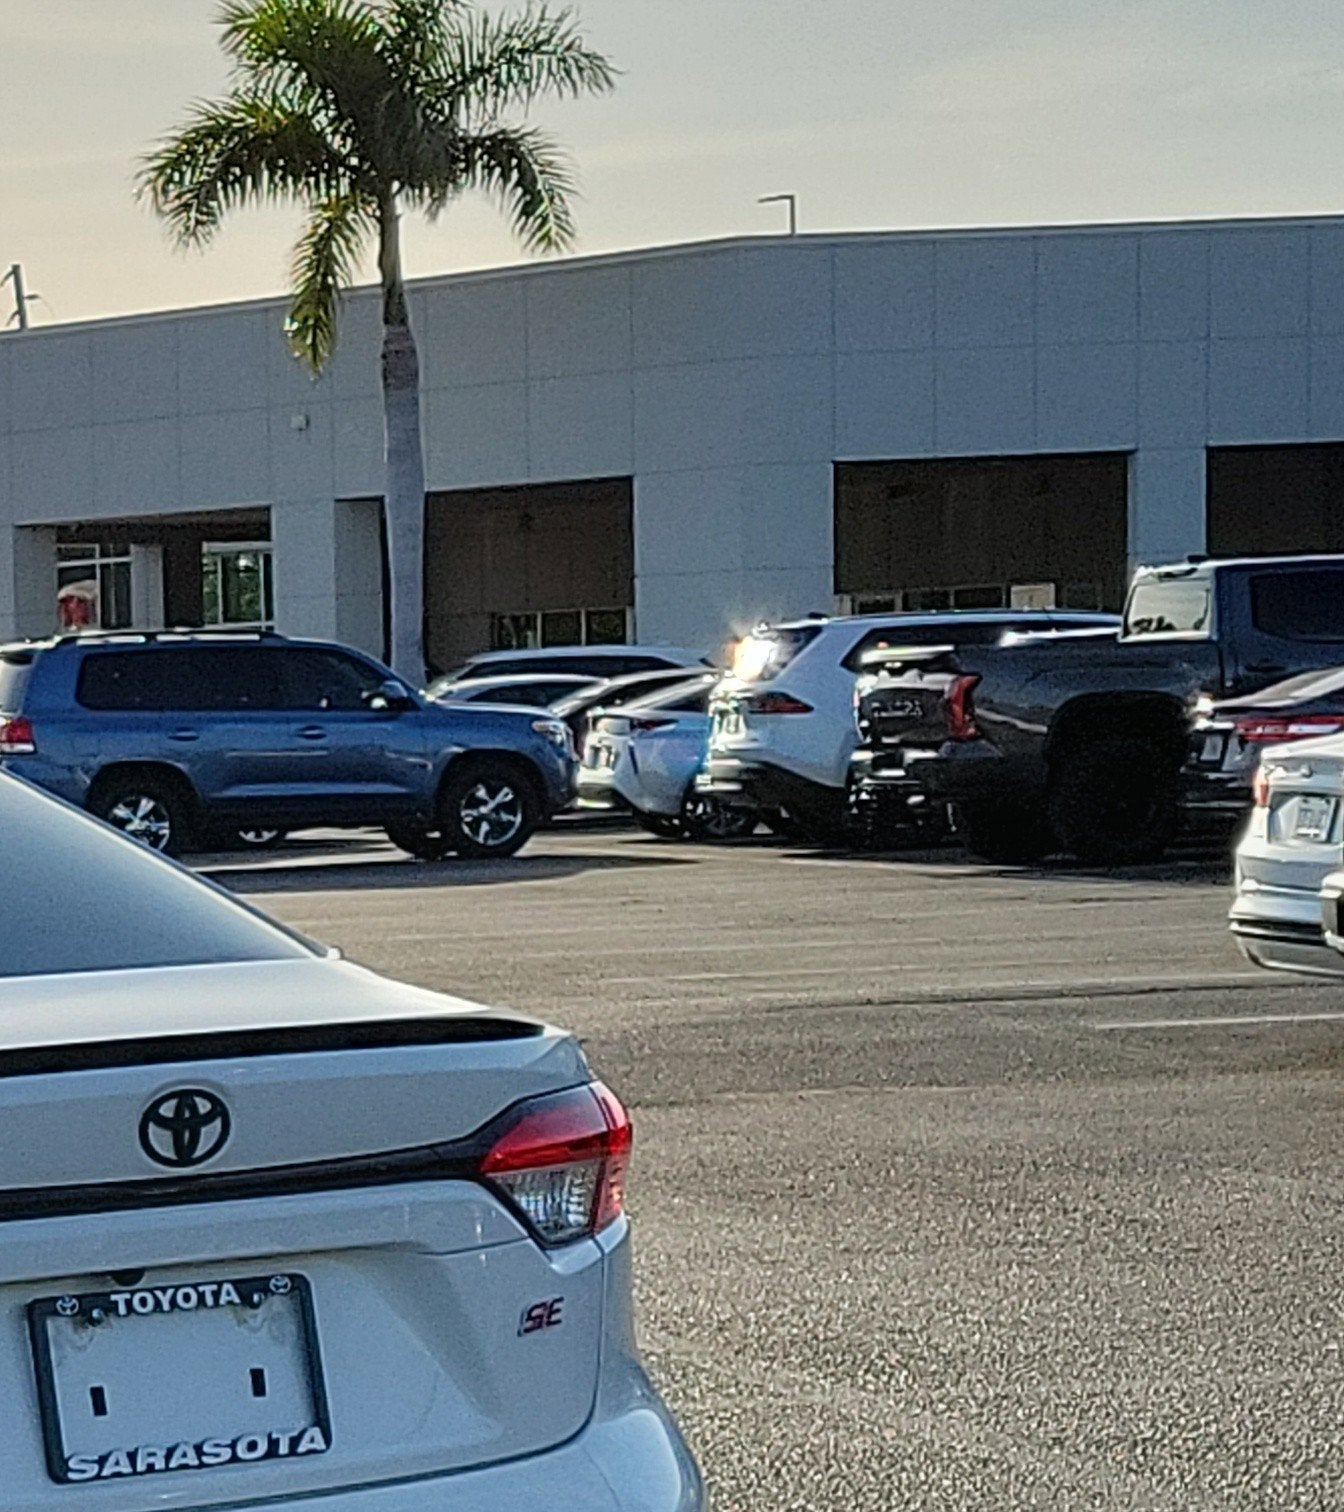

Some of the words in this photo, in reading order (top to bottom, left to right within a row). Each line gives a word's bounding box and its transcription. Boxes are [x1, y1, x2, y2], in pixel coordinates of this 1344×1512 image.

[111, 1283, 240, 1316] TOYOTA
[517, 1296, 564, 1337] SE
[67, 1427, 327, 1480] SARASOTA
